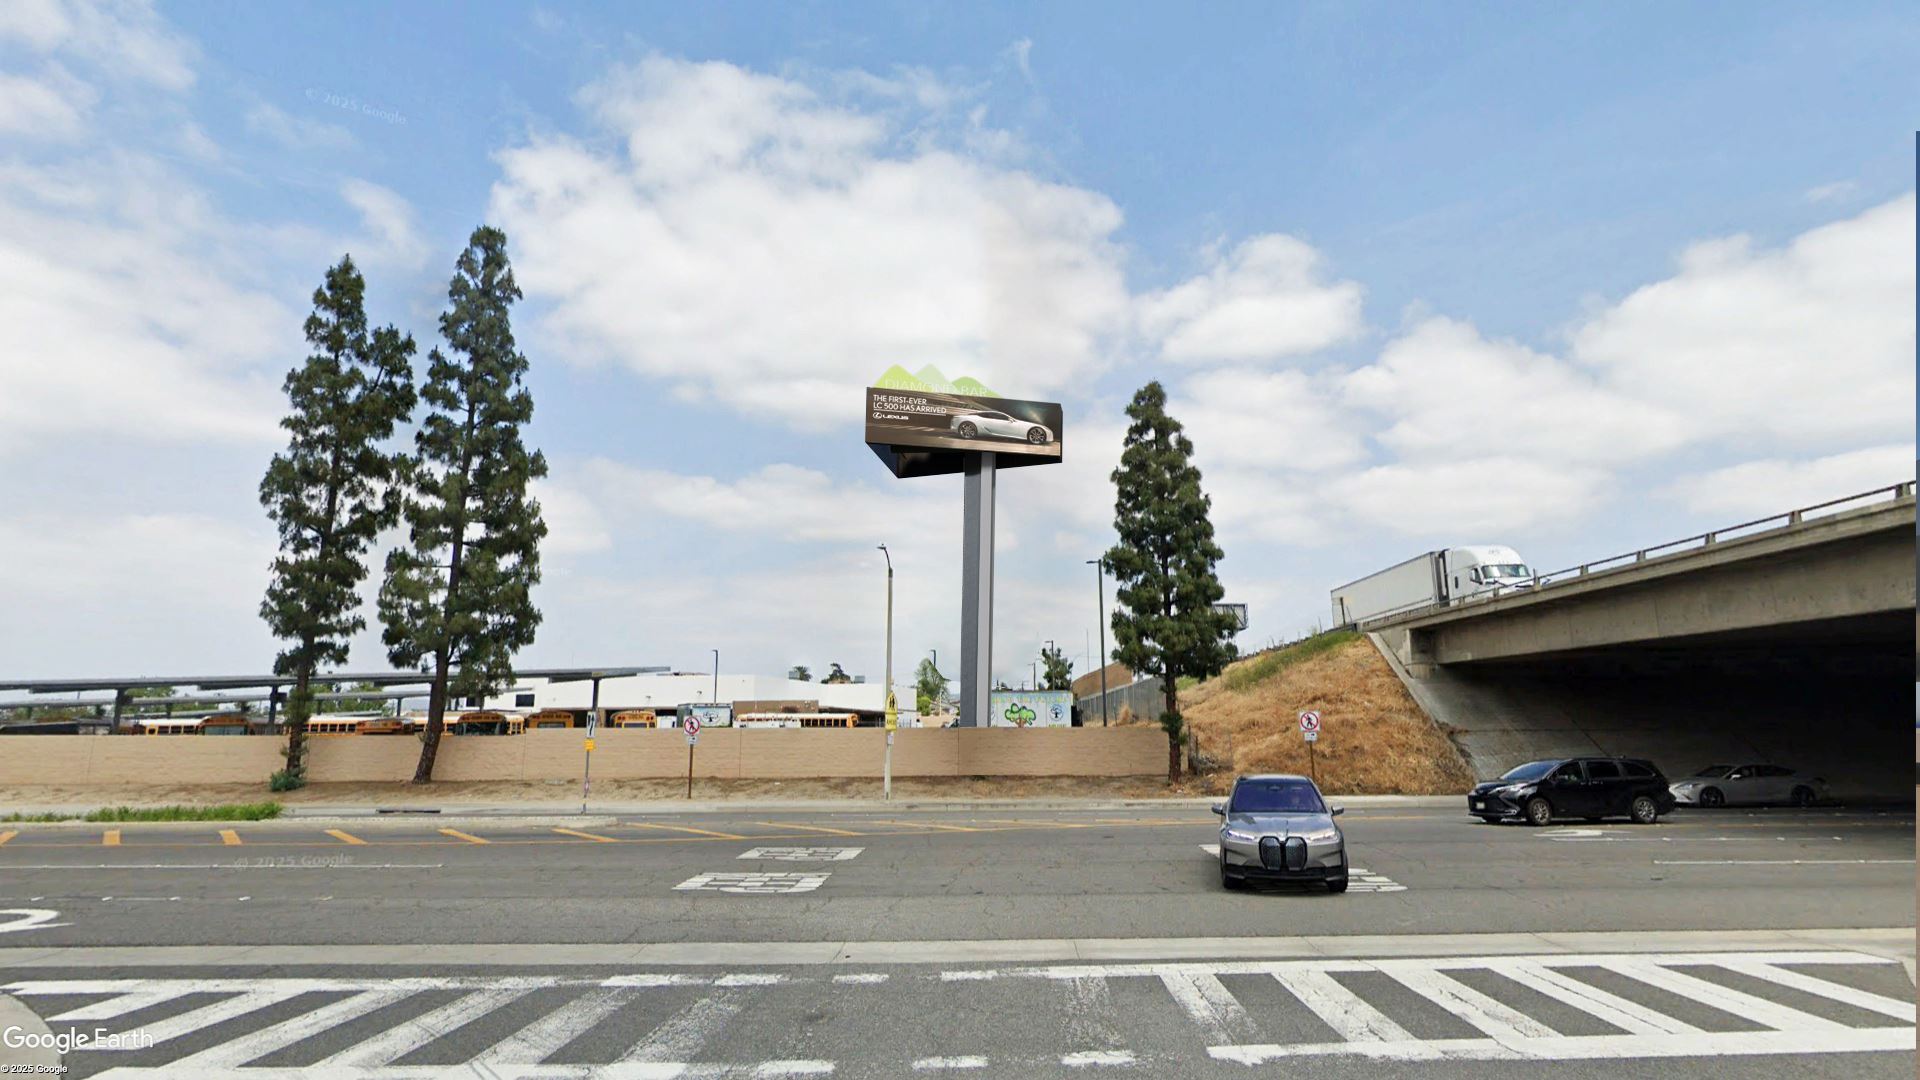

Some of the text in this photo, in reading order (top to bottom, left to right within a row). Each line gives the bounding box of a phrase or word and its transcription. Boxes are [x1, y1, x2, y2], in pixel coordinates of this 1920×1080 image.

[873, 394, 927, 405] THE FIRST-EVER
[915, 405, 947, 414] ARRIVED
